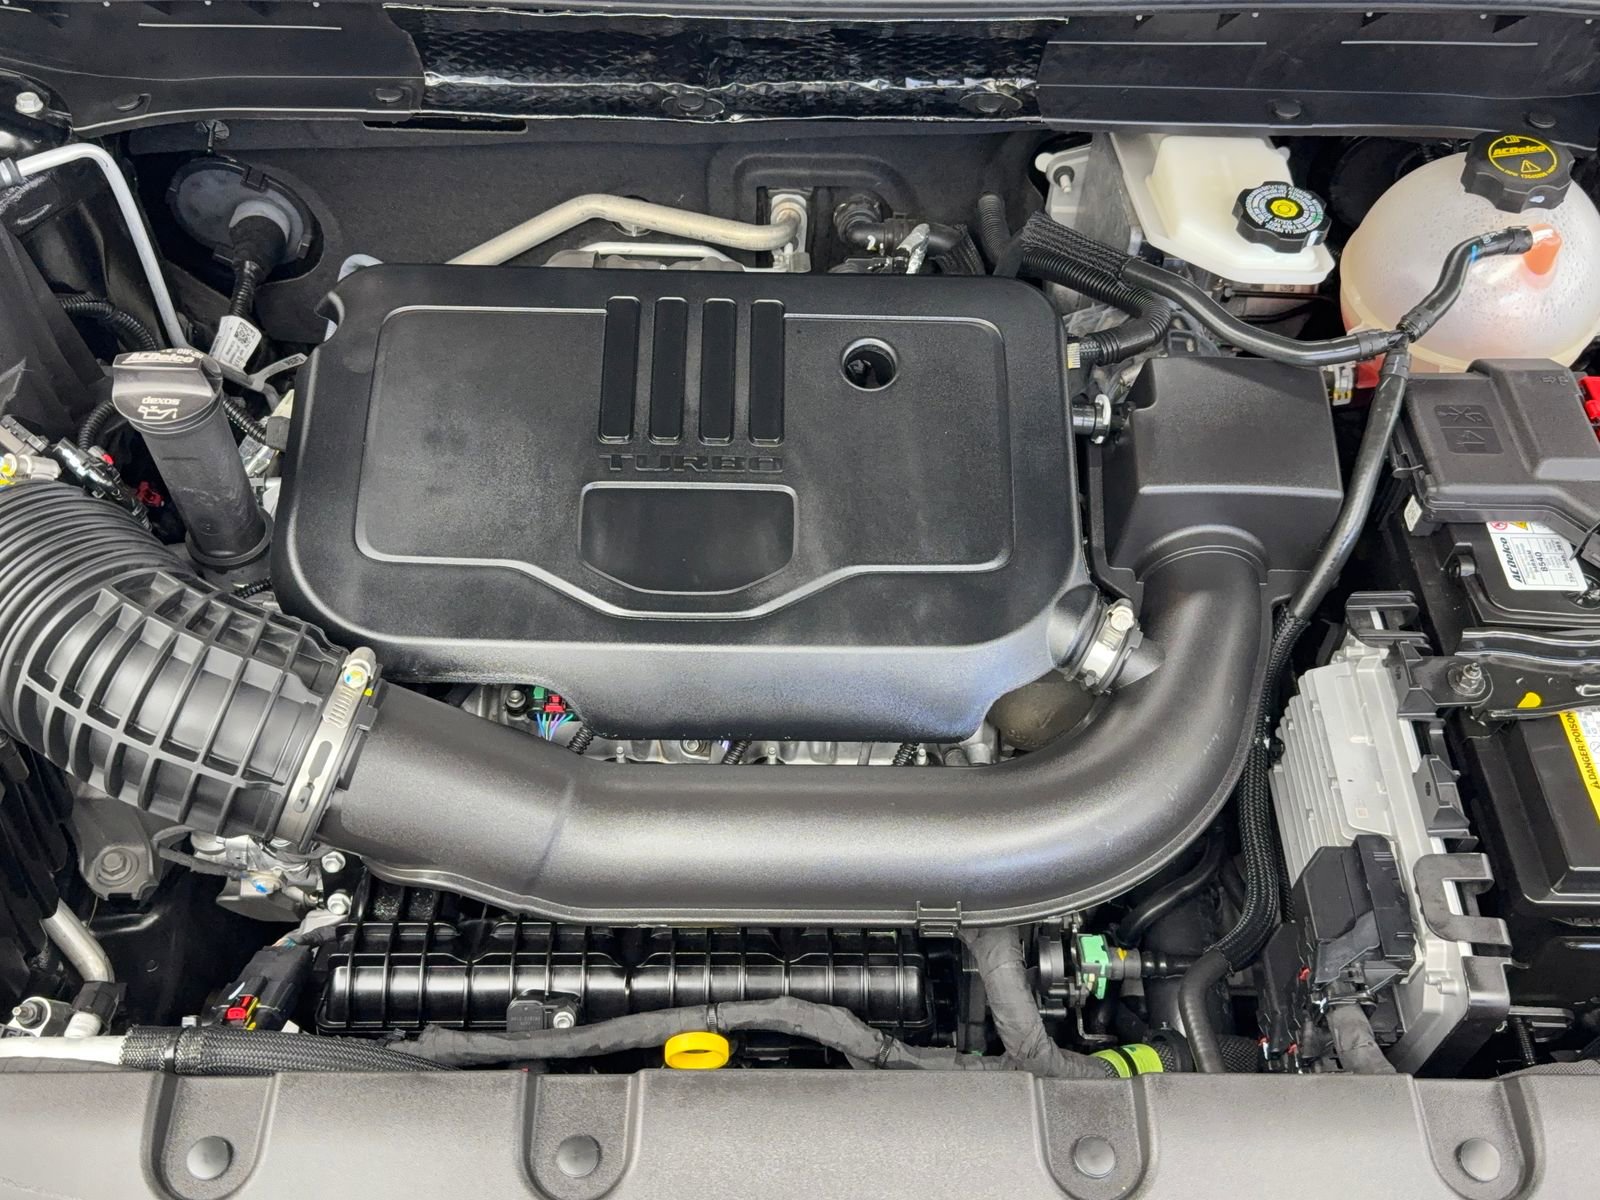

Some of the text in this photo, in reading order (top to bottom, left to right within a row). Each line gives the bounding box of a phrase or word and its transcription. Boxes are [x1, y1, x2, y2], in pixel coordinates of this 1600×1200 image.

[1492, 145, 1547, 157] ACDelco
[122, 352, 195, 364] ACDelco
[141, 396, 181, 406] dexos
[599, 454, 784, 473] TURBO
[1500, 536, 1523, 584] ACDelco
